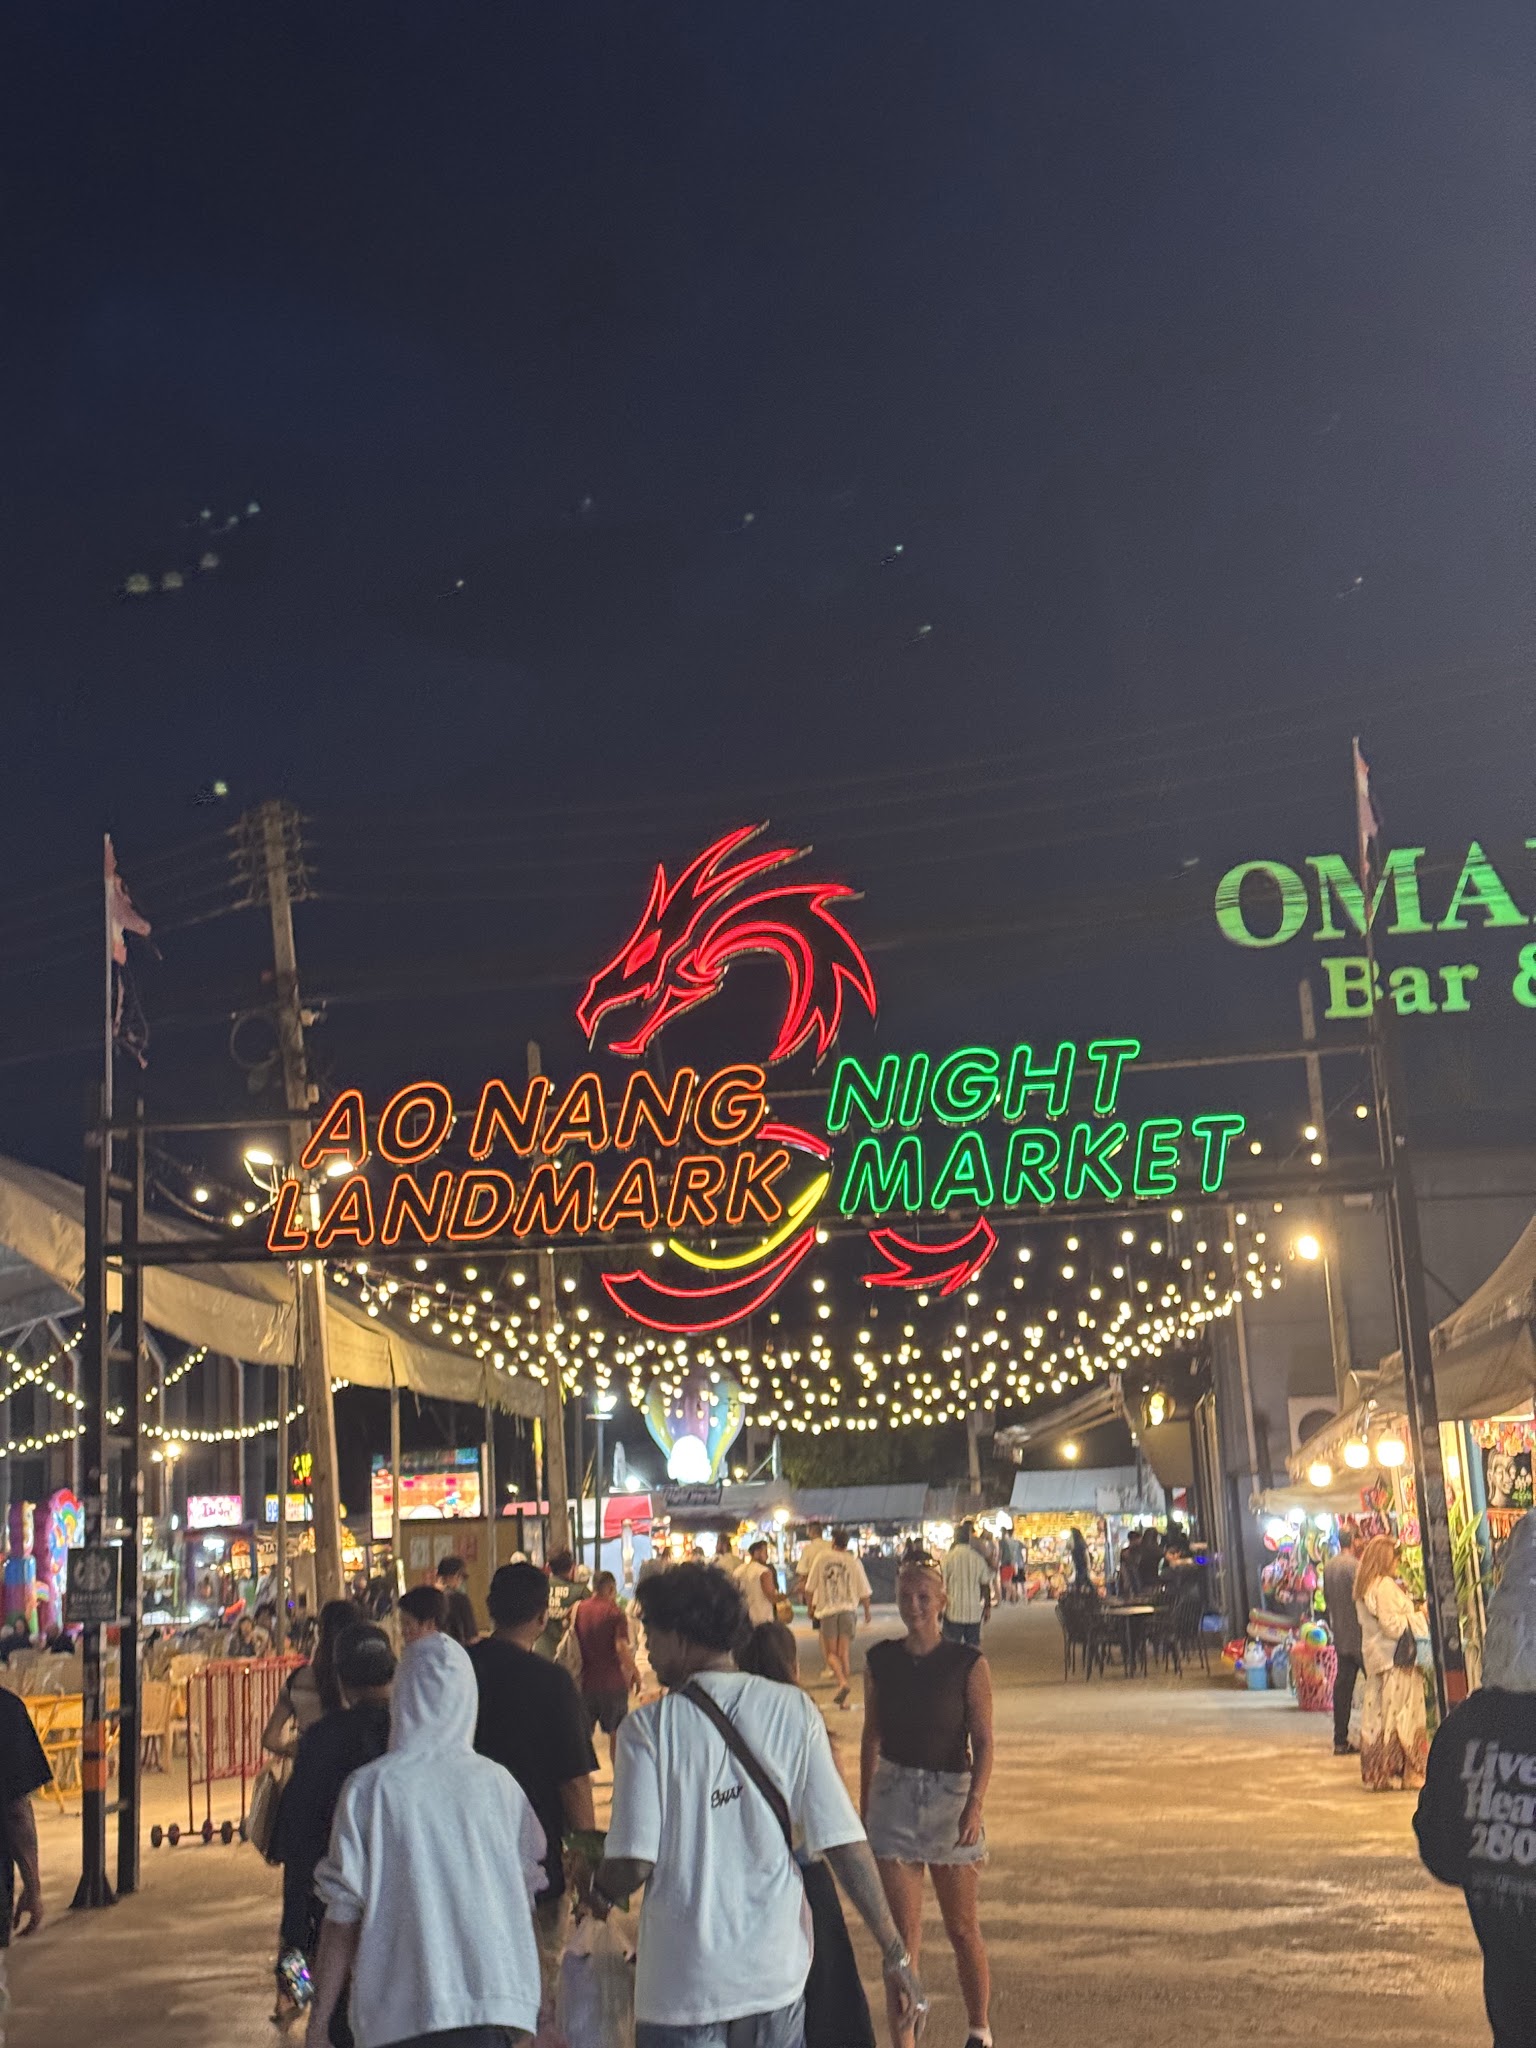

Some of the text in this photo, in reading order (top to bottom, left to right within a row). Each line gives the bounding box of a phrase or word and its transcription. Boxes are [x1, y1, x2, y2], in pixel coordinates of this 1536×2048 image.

[1214, 838, 1536, 948] OMA
[1320, 956, 1479, 1019] Bar
[469, 1064, 766, 1161] NANG
[825, 1038, 1142, 1134] NIGHT
[267, 1150, 790, 1252] LANDMARK
[839, 1113, 1246, 1216] MARKET
[1461, 1740, 1536, 1784] Live
[1465, 1779, 1536, 1823] Hea
